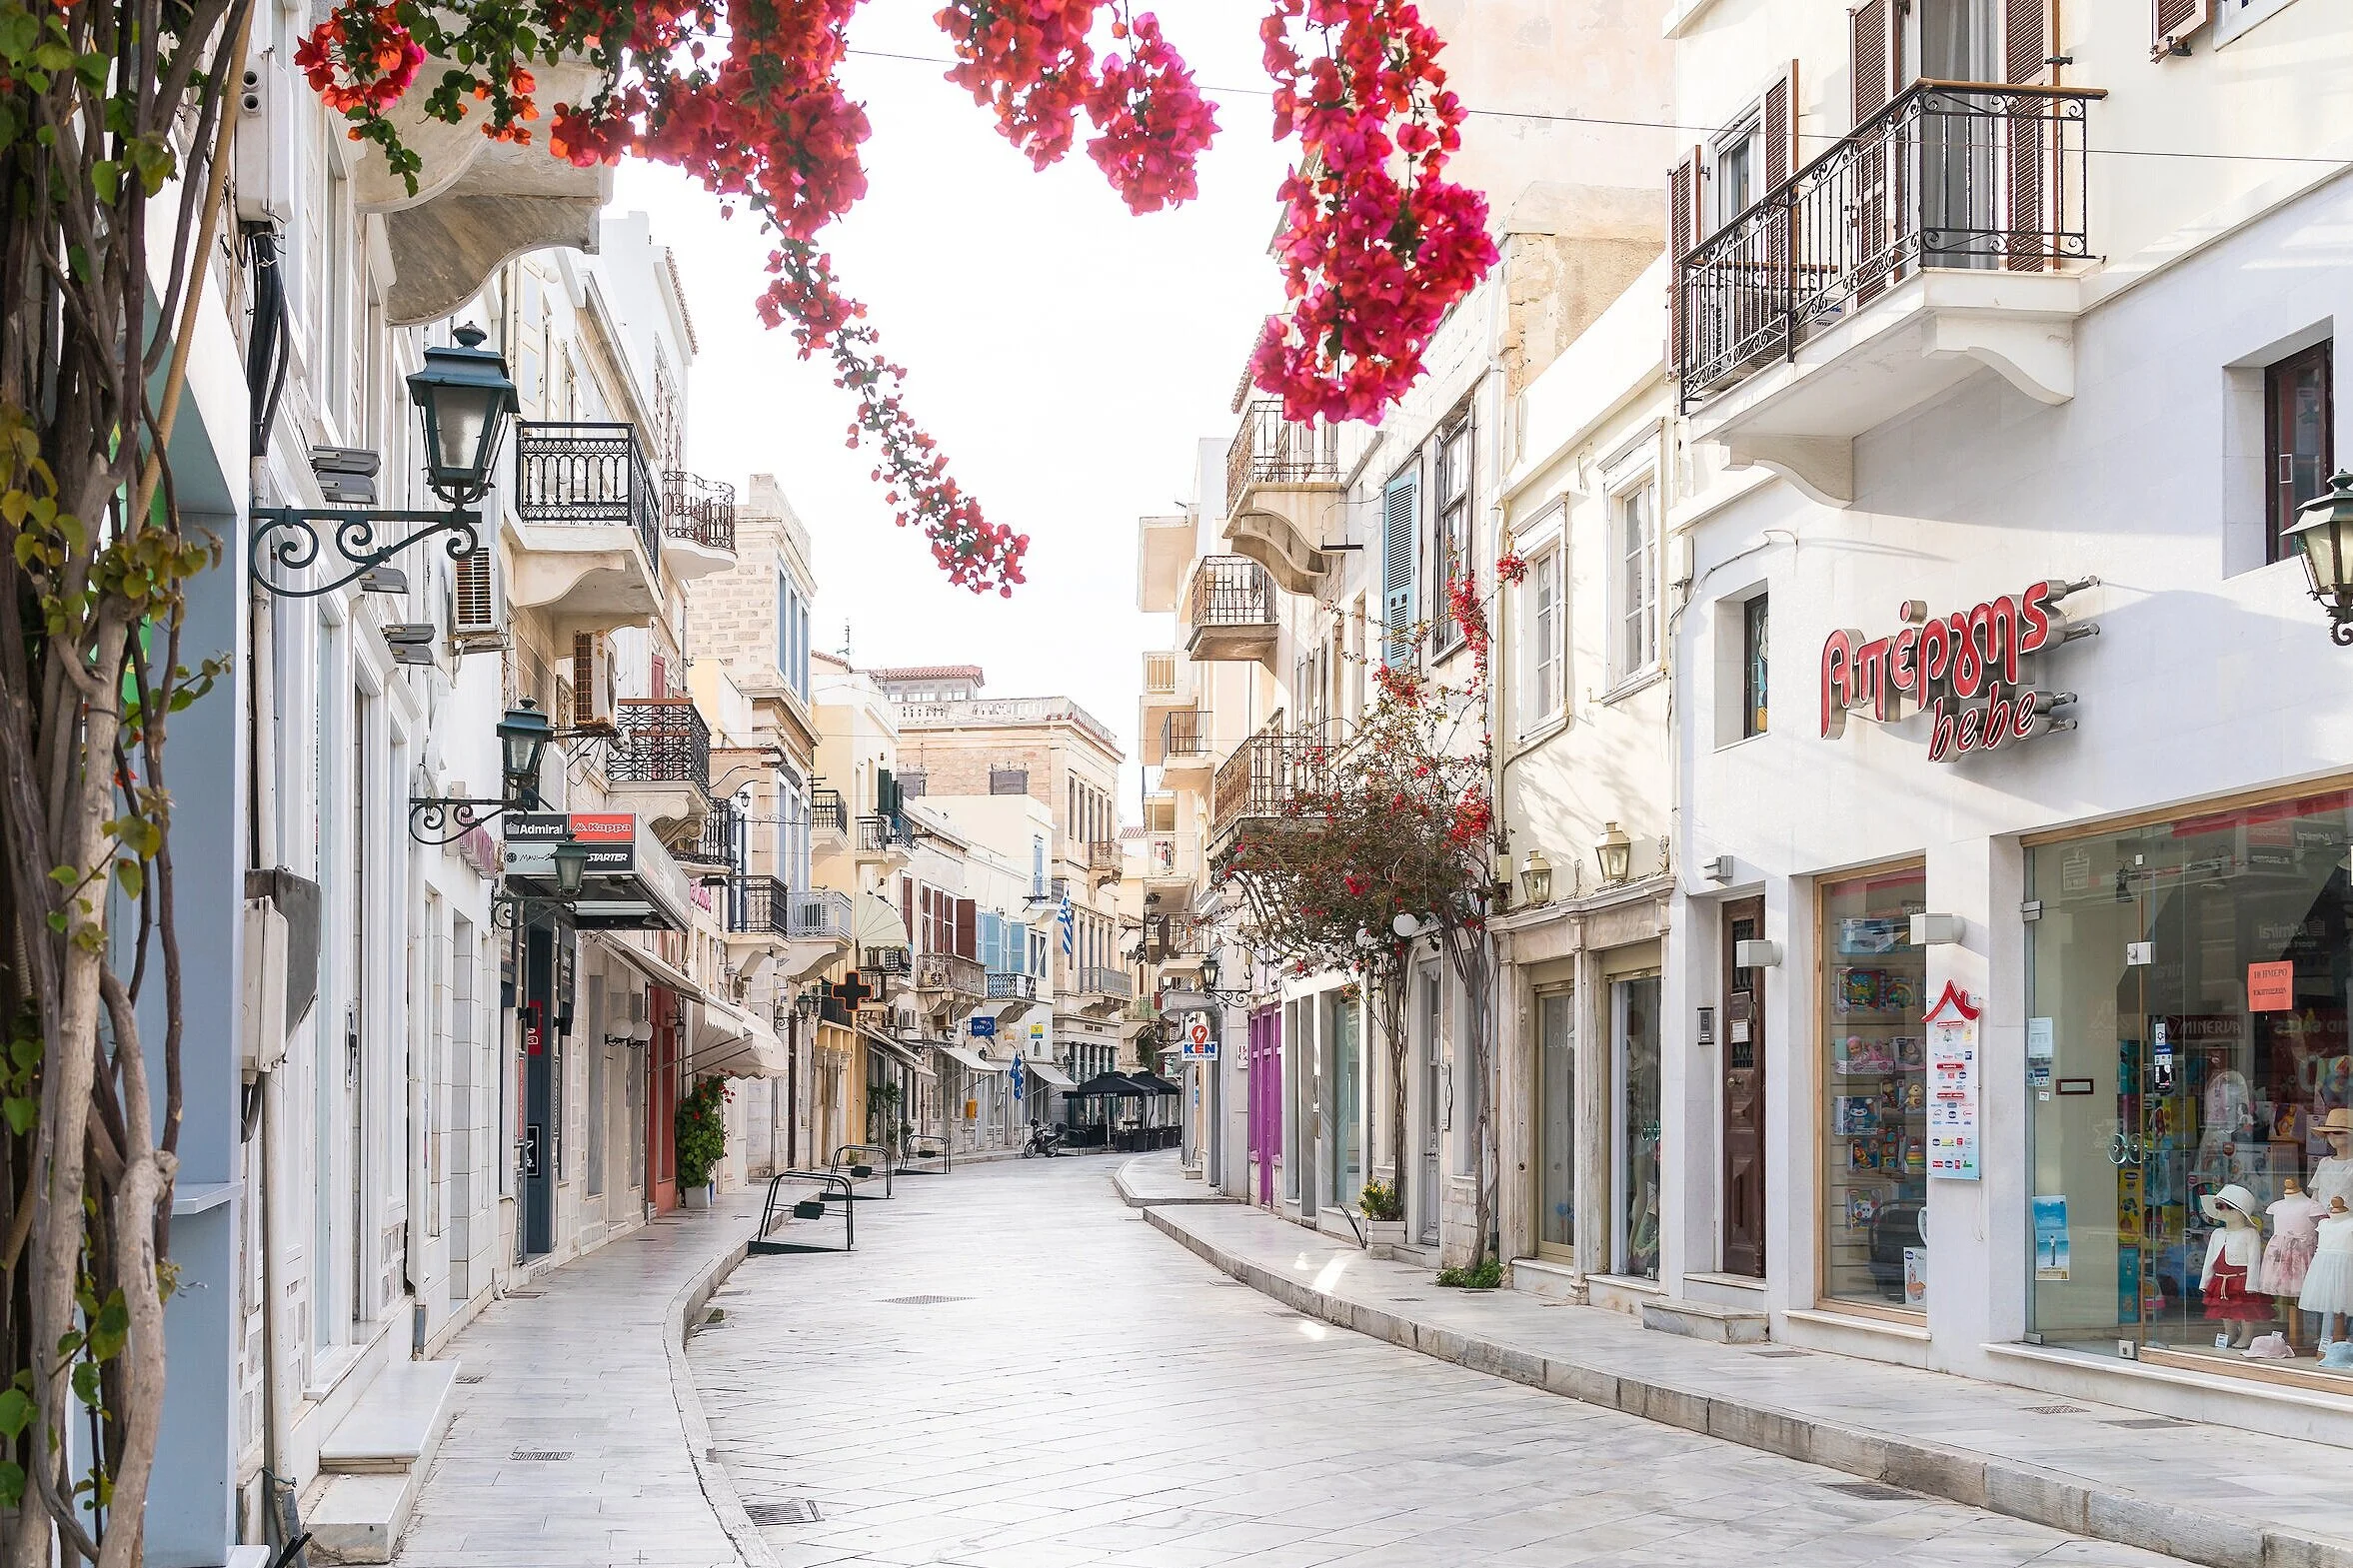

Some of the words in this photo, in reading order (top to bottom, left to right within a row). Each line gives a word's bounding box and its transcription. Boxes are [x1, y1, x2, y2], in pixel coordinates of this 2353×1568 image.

[1927, 681, 2037, 763] bebe
[520, 822, 564, 834] Admiral
[588, 822, 632, 833] Kappa
[587, 852, 629, 862] STARTER
[1183, 1044, 1215, 1053] KEN
